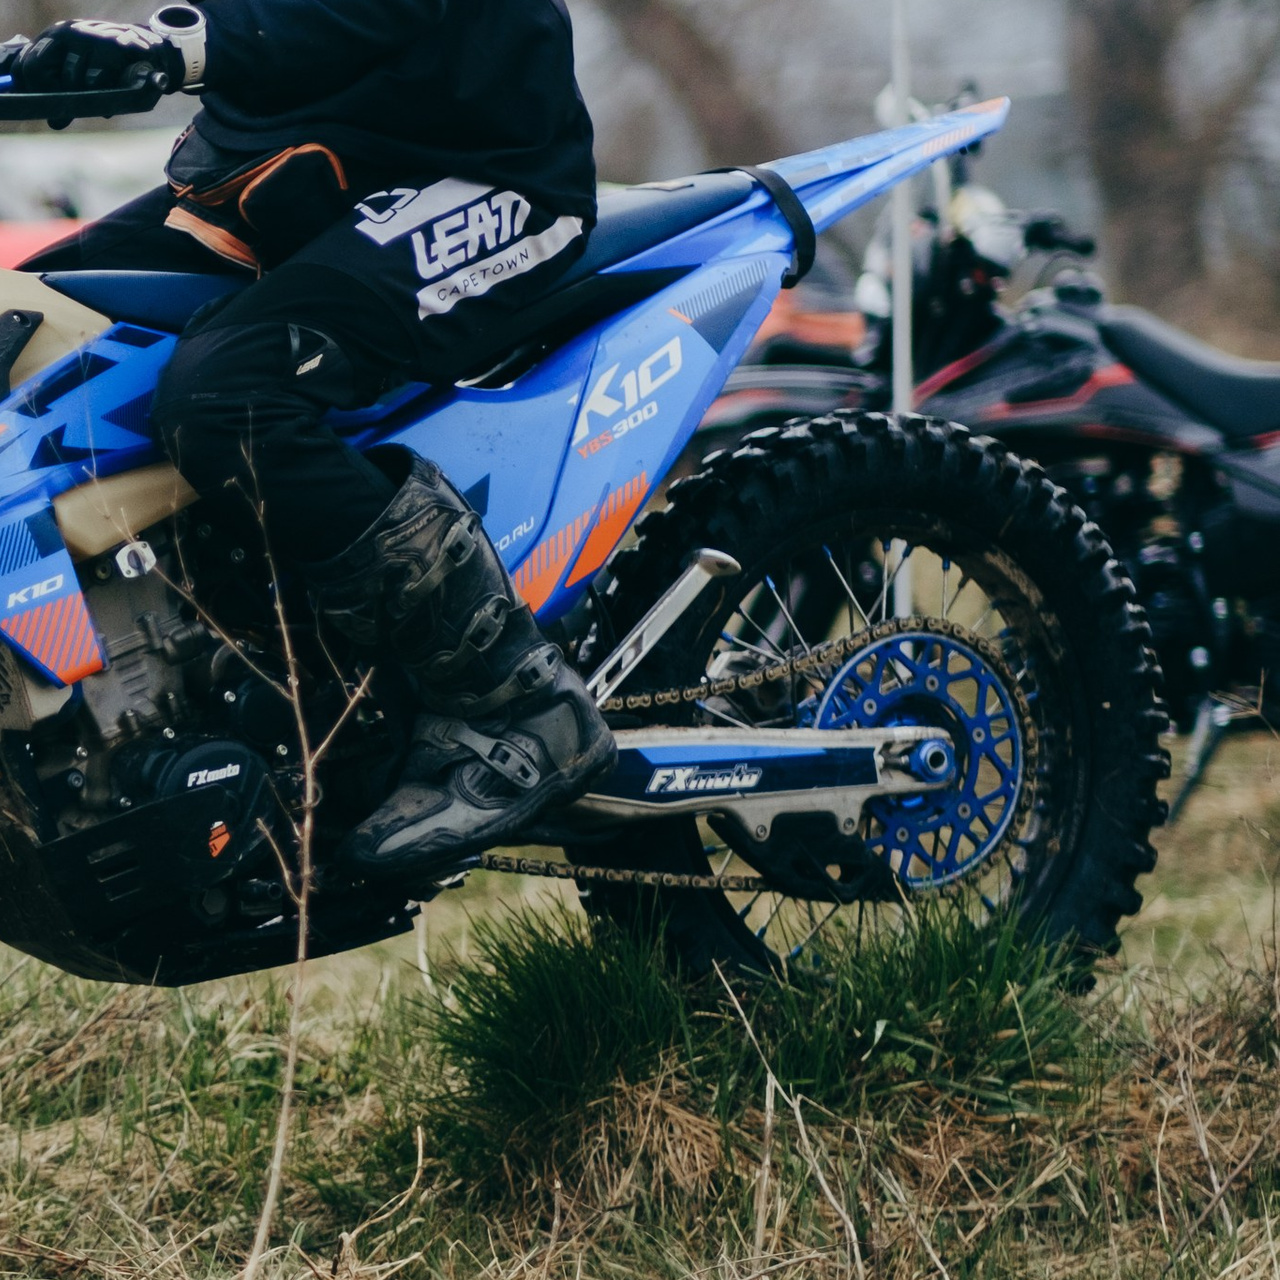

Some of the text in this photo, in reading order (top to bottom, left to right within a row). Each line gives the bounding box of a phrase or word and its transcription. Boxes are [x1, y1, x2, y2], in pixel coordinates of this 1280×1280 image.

[437, 248, 529, 301] CAPETOWN
[567, 336, 682, 447] K10
[7, 574, 63, 609] K10
[187, 763, 240, 788] FXmoto
[645, 763, 762, 794] FXmoto
